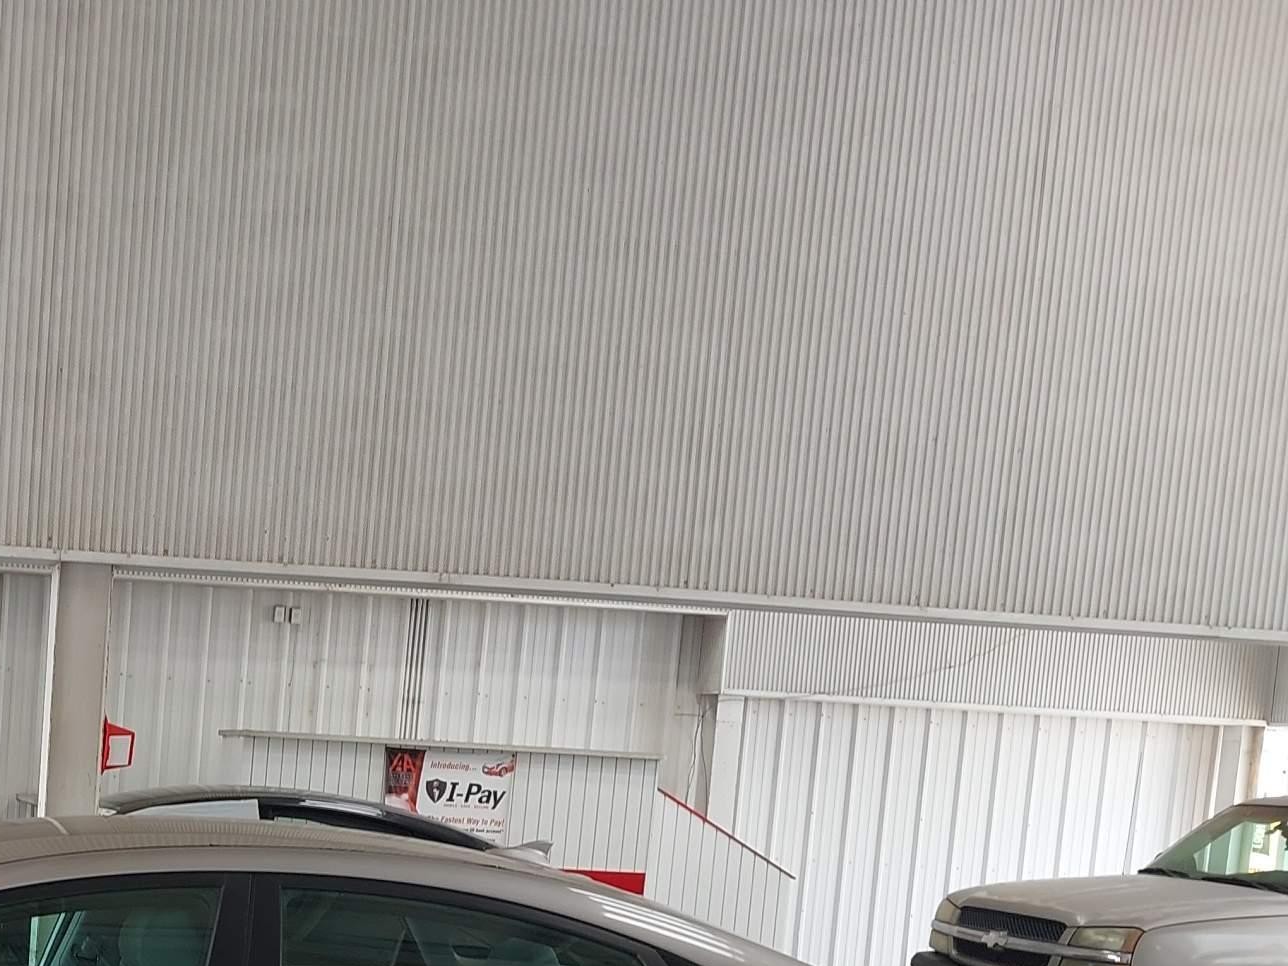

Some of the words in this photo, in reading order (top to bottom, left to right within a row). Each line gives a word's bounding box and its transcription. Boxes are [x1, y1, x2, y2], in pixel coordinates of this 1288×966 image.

[445, 781, 507, 810] I-Pay
[440, 815, 465, 825] Fastest
[466, 816, 480, 827] Way
[481, 817, 489, 826] to
